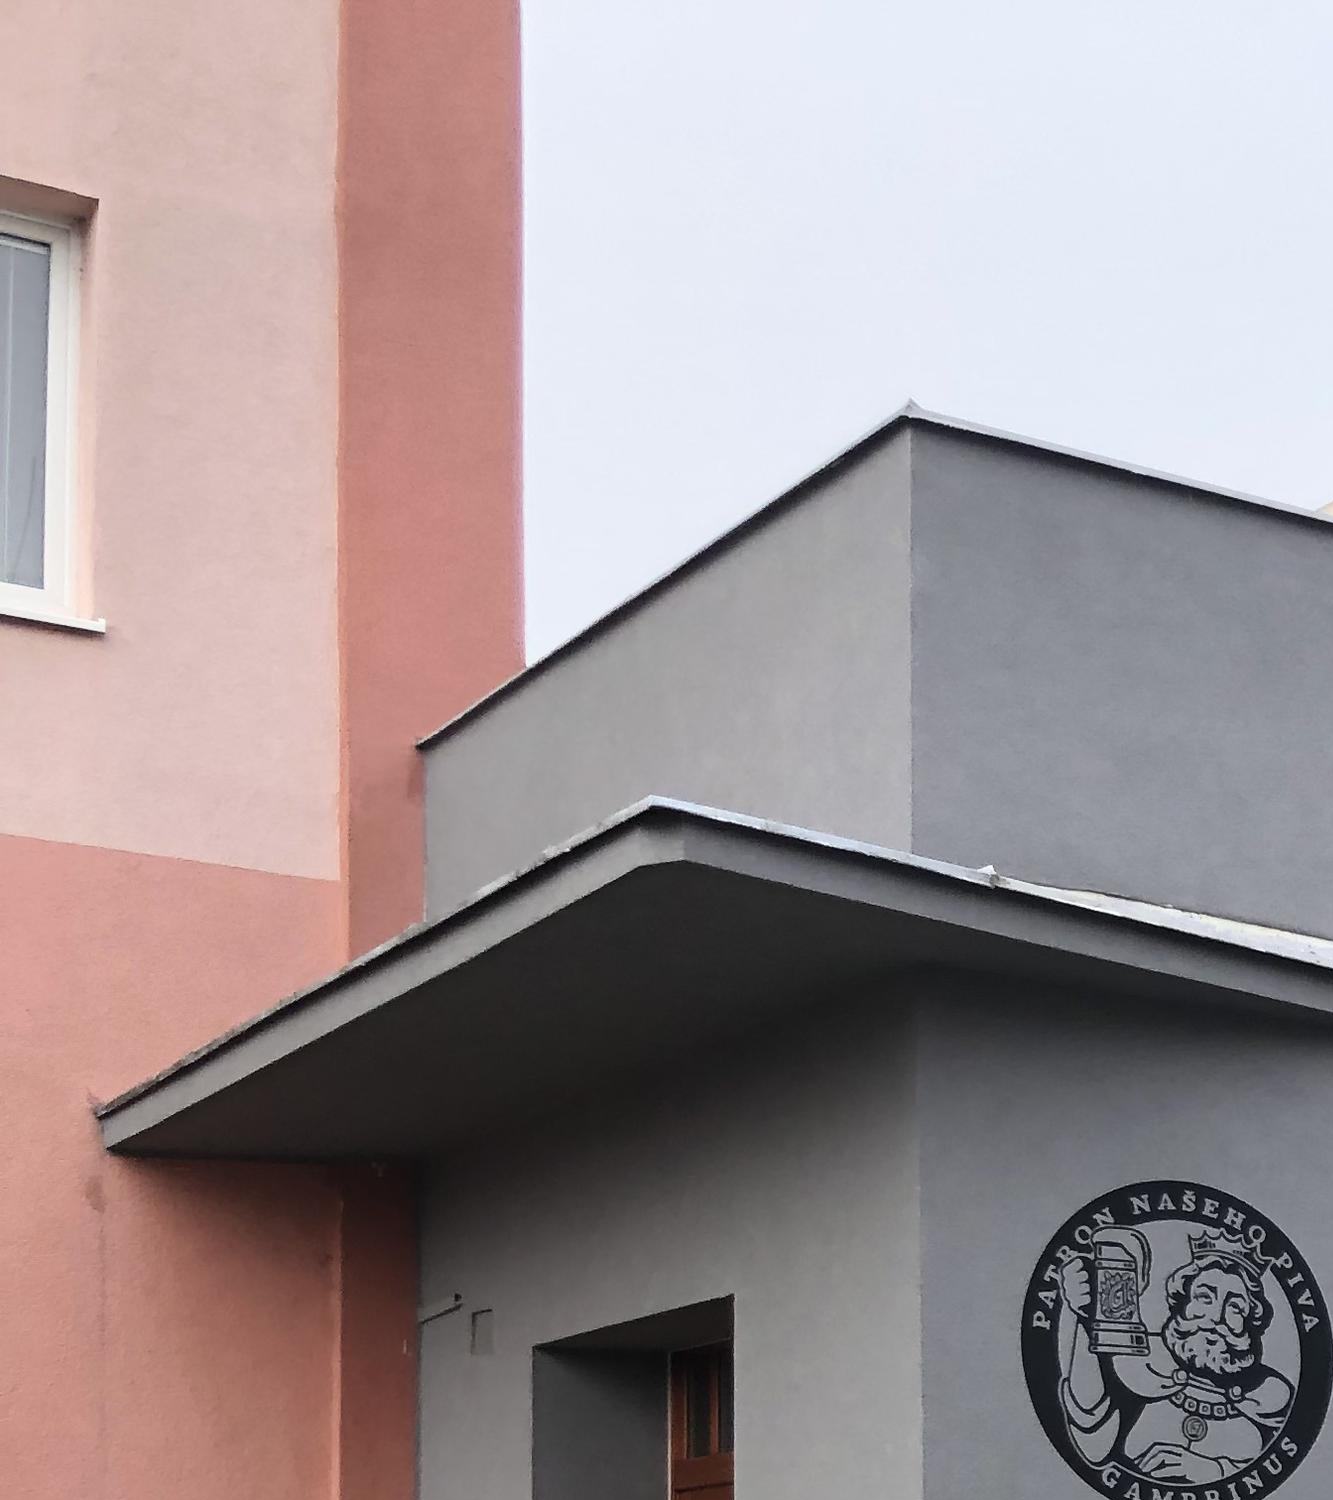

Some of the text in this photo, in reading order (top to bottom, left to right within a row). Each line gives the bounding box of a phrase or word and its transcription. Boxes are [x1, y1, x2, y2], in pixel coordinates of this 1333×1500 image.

[1032, 1189, 1321, 1333] PATRON NAŠEHO PIVA
